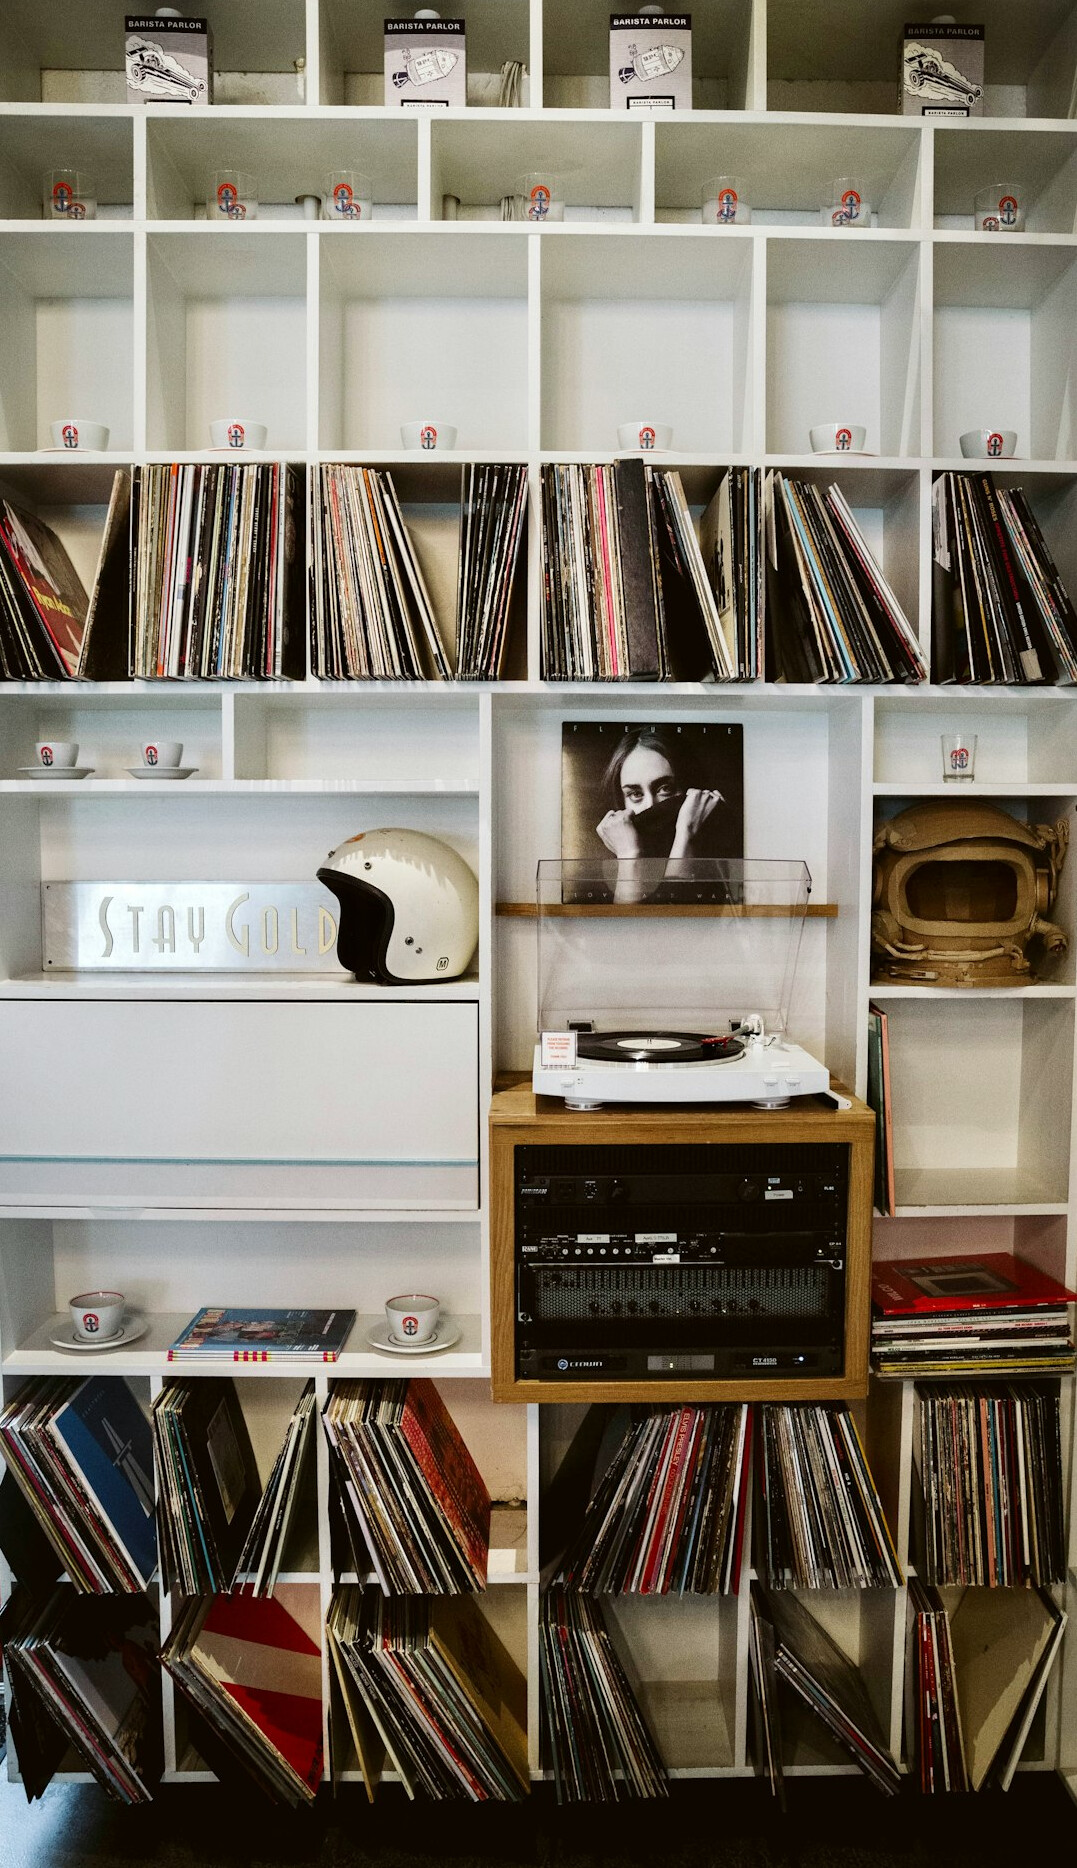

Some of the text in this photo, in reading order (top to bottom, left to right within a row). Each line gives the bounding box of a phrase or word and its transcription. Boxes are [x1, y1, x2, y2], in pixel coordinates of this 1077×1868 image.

[167, 21, 202, 29] PARLOR
[982, 479, 991, 495] GUNS
[988, 502, 998, 521] ROSES
[100, 892, 338, 958] STAY GOLD
[672, 1412, 691, 1466] ELVIS PRESLEY
